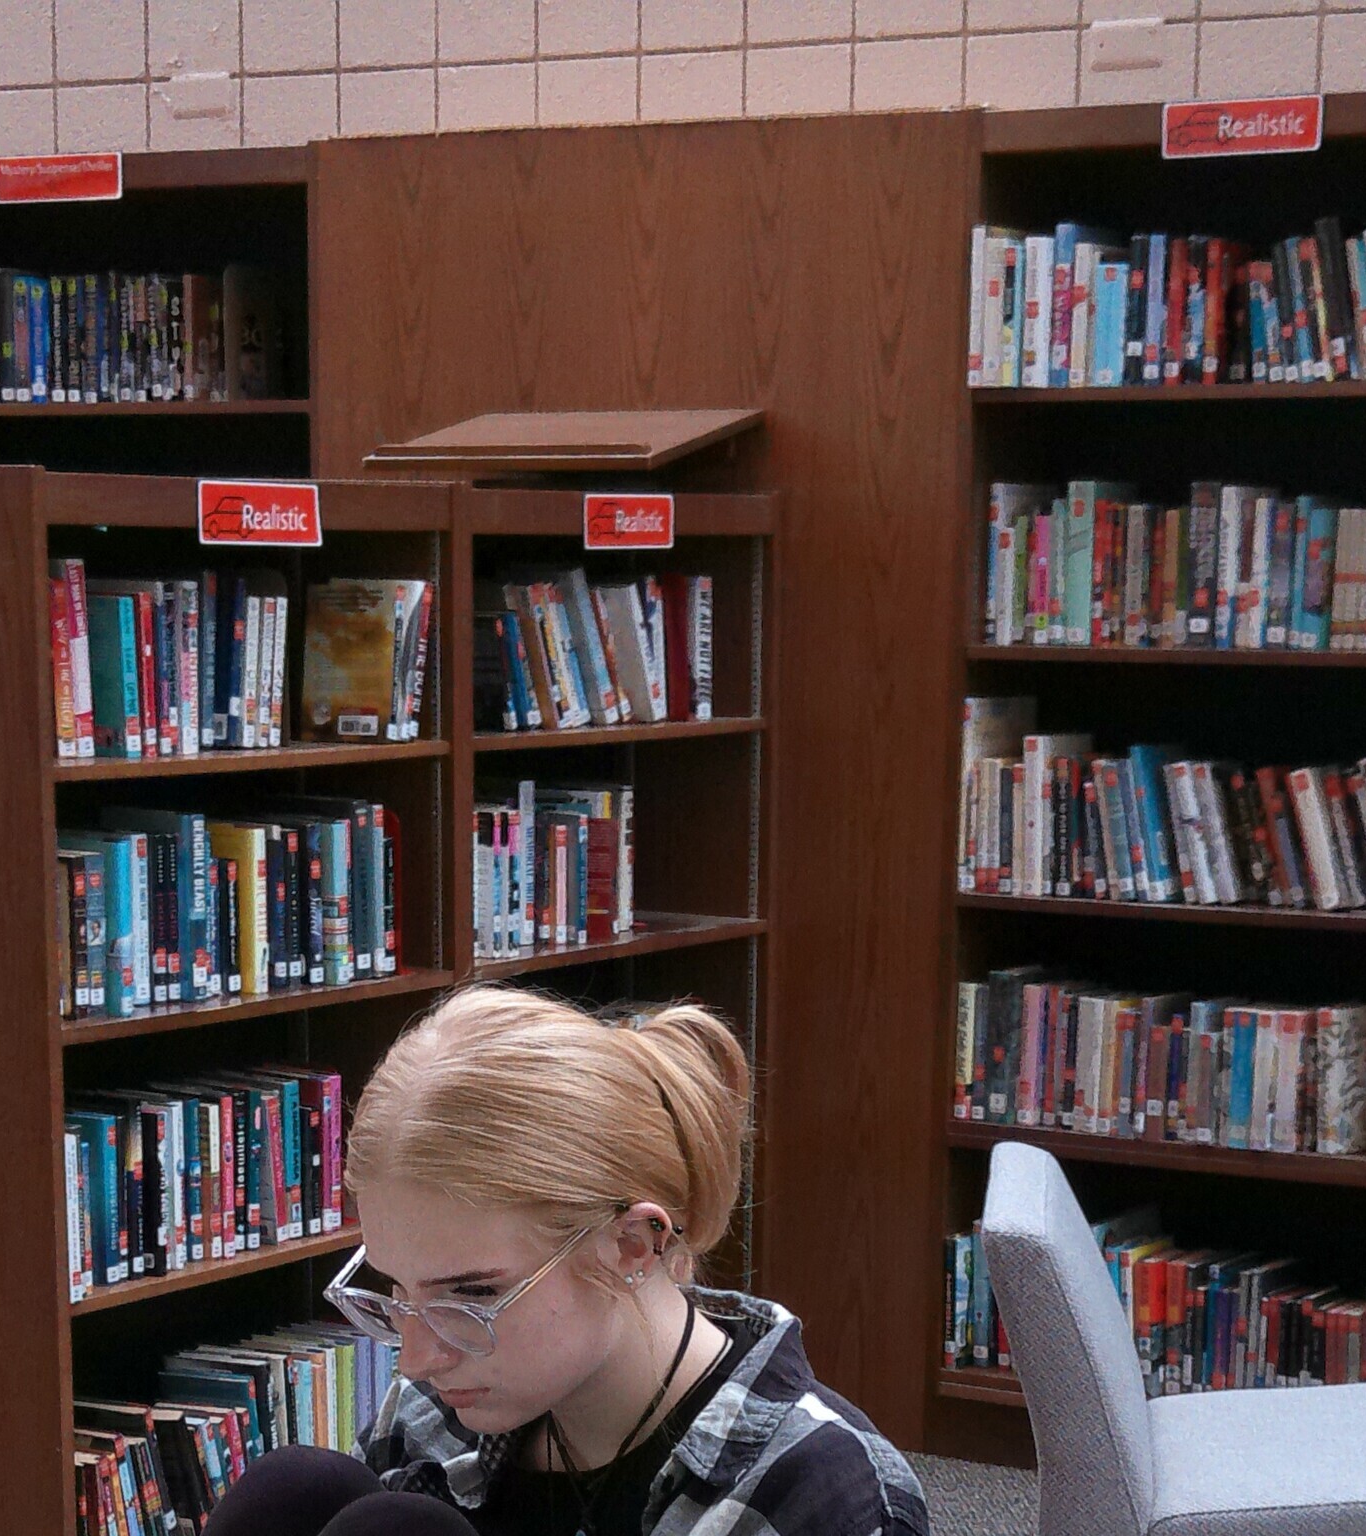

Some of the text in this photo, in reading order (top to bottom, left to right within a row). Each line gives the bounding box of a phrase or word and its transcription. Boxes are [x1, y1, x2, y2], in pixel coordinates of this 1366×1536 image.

[1217, 111, 1307, 139] Realistic
[242, 504, 309, 532] Realistic
[615, 509, 663, 532] Realistic
[309, 896, 322, 936] Sacred
